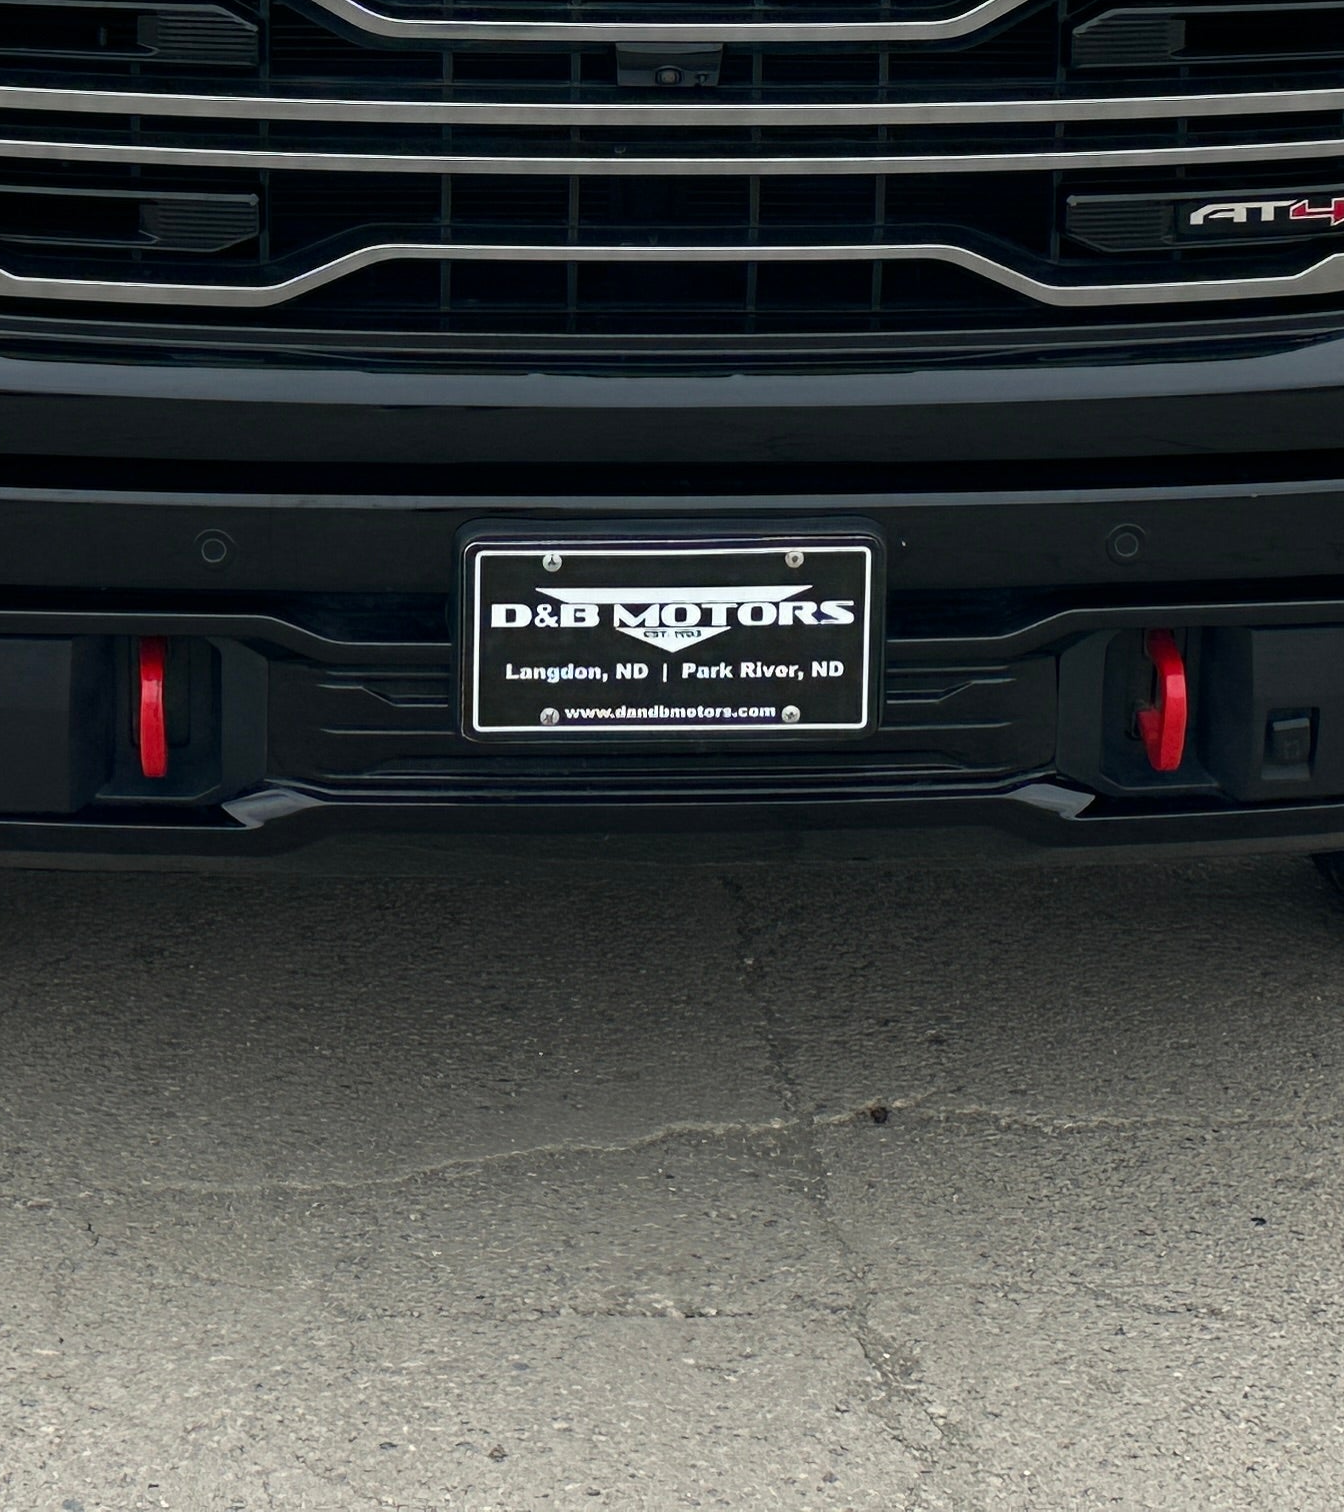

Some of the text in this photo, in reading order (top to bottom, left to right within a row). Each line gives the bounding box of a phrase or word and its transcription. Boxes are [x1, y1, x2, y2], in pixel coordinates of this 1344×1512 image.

[490, 600, 855, 628] D&B MOTORS
[505, 660, 845, 683] Langdon, ND Park River, ND
[564, 704, 776, 718] www.dandbmotors.com
